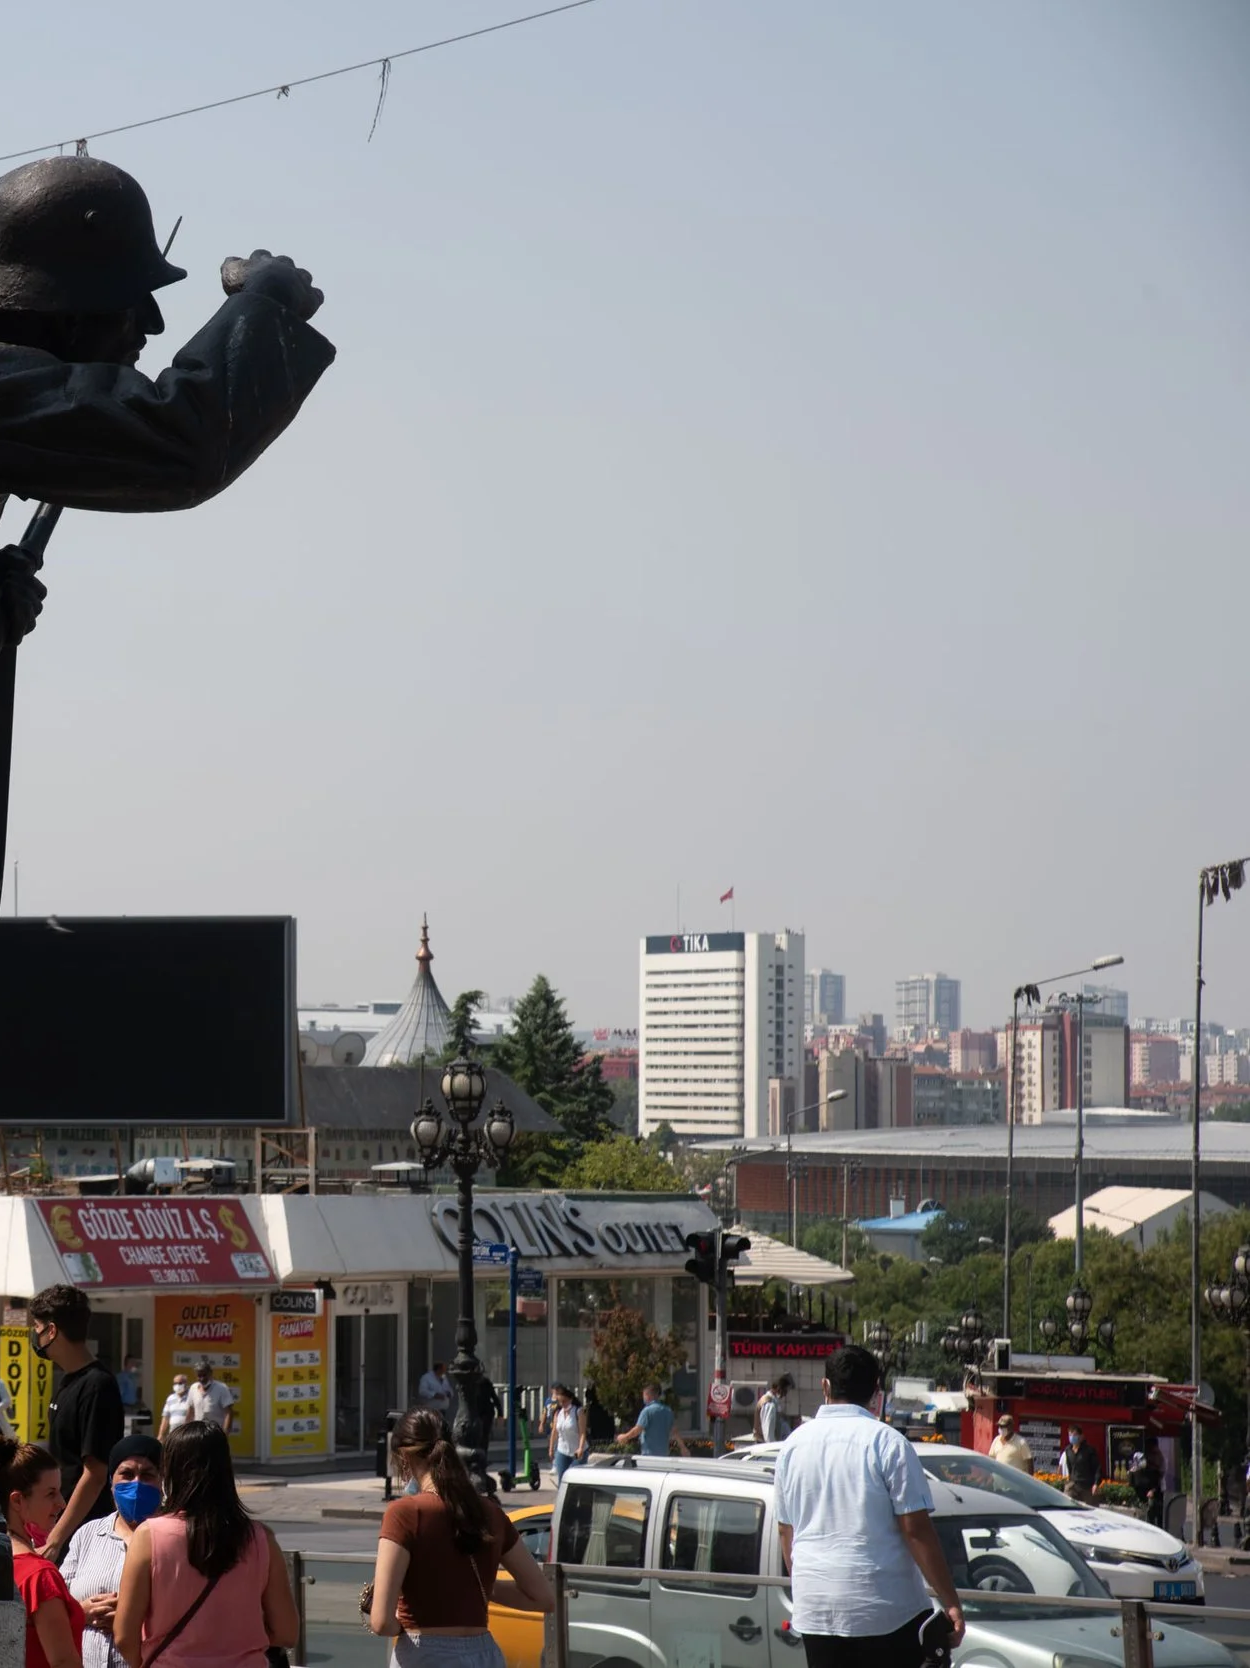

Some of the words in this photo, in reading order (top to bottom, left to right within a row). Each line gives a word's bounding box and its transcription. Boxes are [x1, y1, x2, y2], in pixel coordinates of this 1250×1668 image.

[78, 1202, 141, 1240] GÖZDE
[133, 1202, 191, 1240] DÖVİZ
[186, 1208, 226, 1244] A.Ş.
[432, 1199, 598, 1258] COLIN'S
[599, 1221, 691, 1256] OUTLET
[119, 1245, 169, 1265] CHANGE
[167, 1245, 210, 1265] OFFICE
[273, 1294, 315, 1310] COLIN'S
[181, 1303, 230, 1321] OUTLET
[174, 1322, 234, 1340] PANAYIRI
[279, 1319, 314, 1338] PANAYIRI
[732, 1339, 773, 1356] TÜRK
